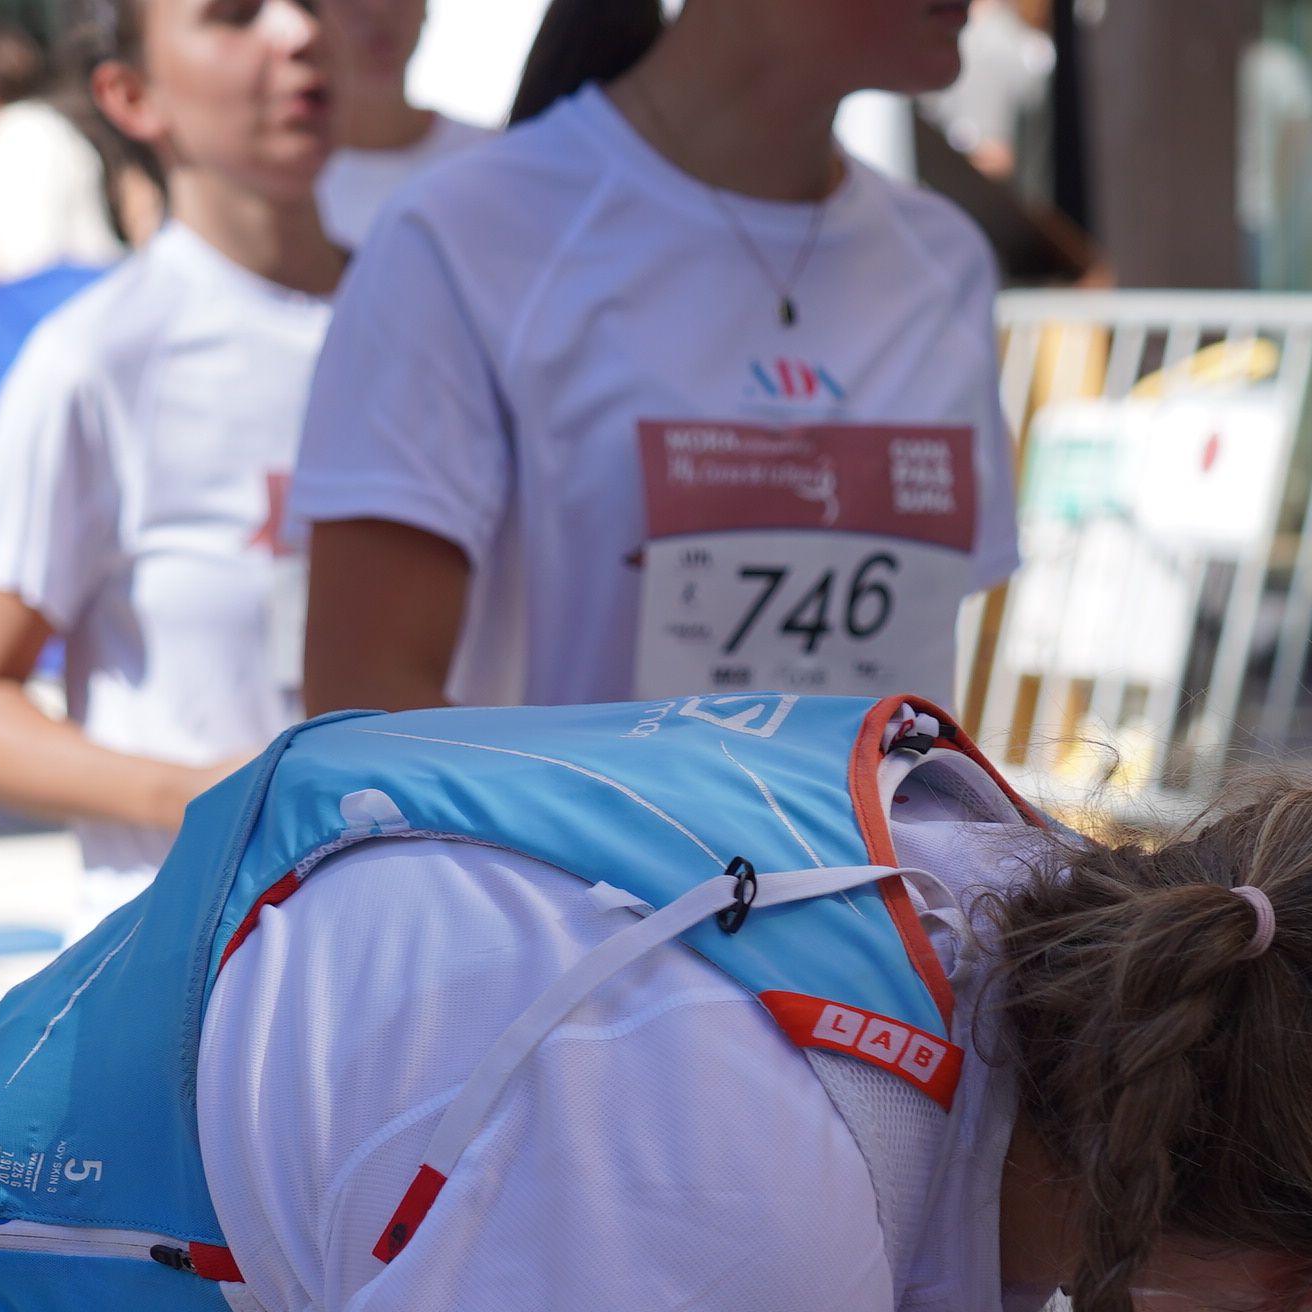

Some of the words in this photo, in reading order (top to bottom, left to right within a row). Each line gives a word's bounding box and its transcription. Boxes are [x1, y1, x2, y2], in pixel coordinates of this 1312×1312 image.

[721, 552, 900, 656] 746
[829, 1012, 935, 1069] LAB
[11, 1161, 26, 1179] 225
[49, 1162, 62, 1185] SKIN
[64, 1157, 103, 1182] 5
